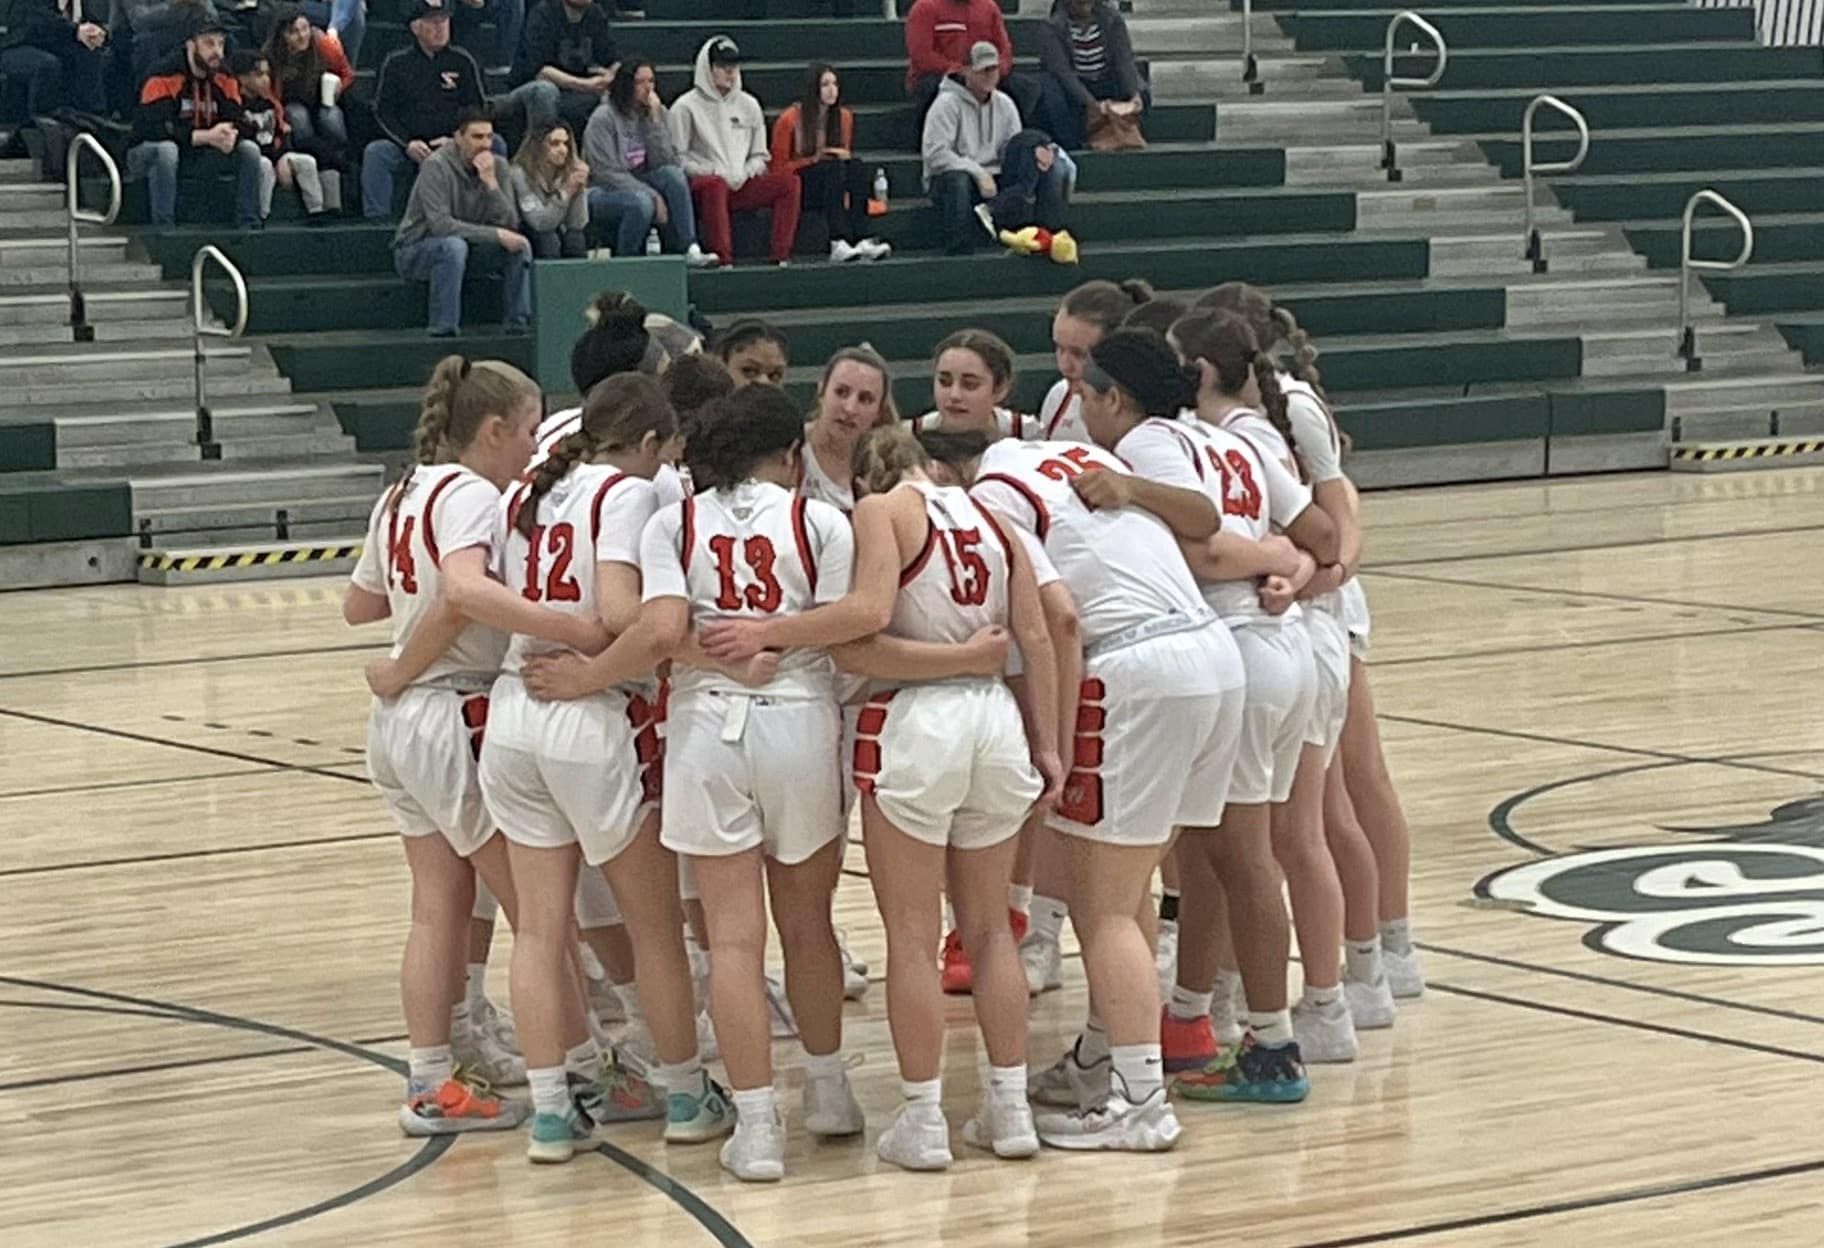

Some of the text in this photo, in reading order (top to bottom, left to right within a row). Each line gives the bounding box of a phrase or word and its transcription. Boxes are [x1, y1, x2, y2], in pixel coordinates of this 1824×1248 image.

[521, 522, 582, 602] 12
[709, 534, 783, 613] 13
[938, 526, 991, 606] 15
